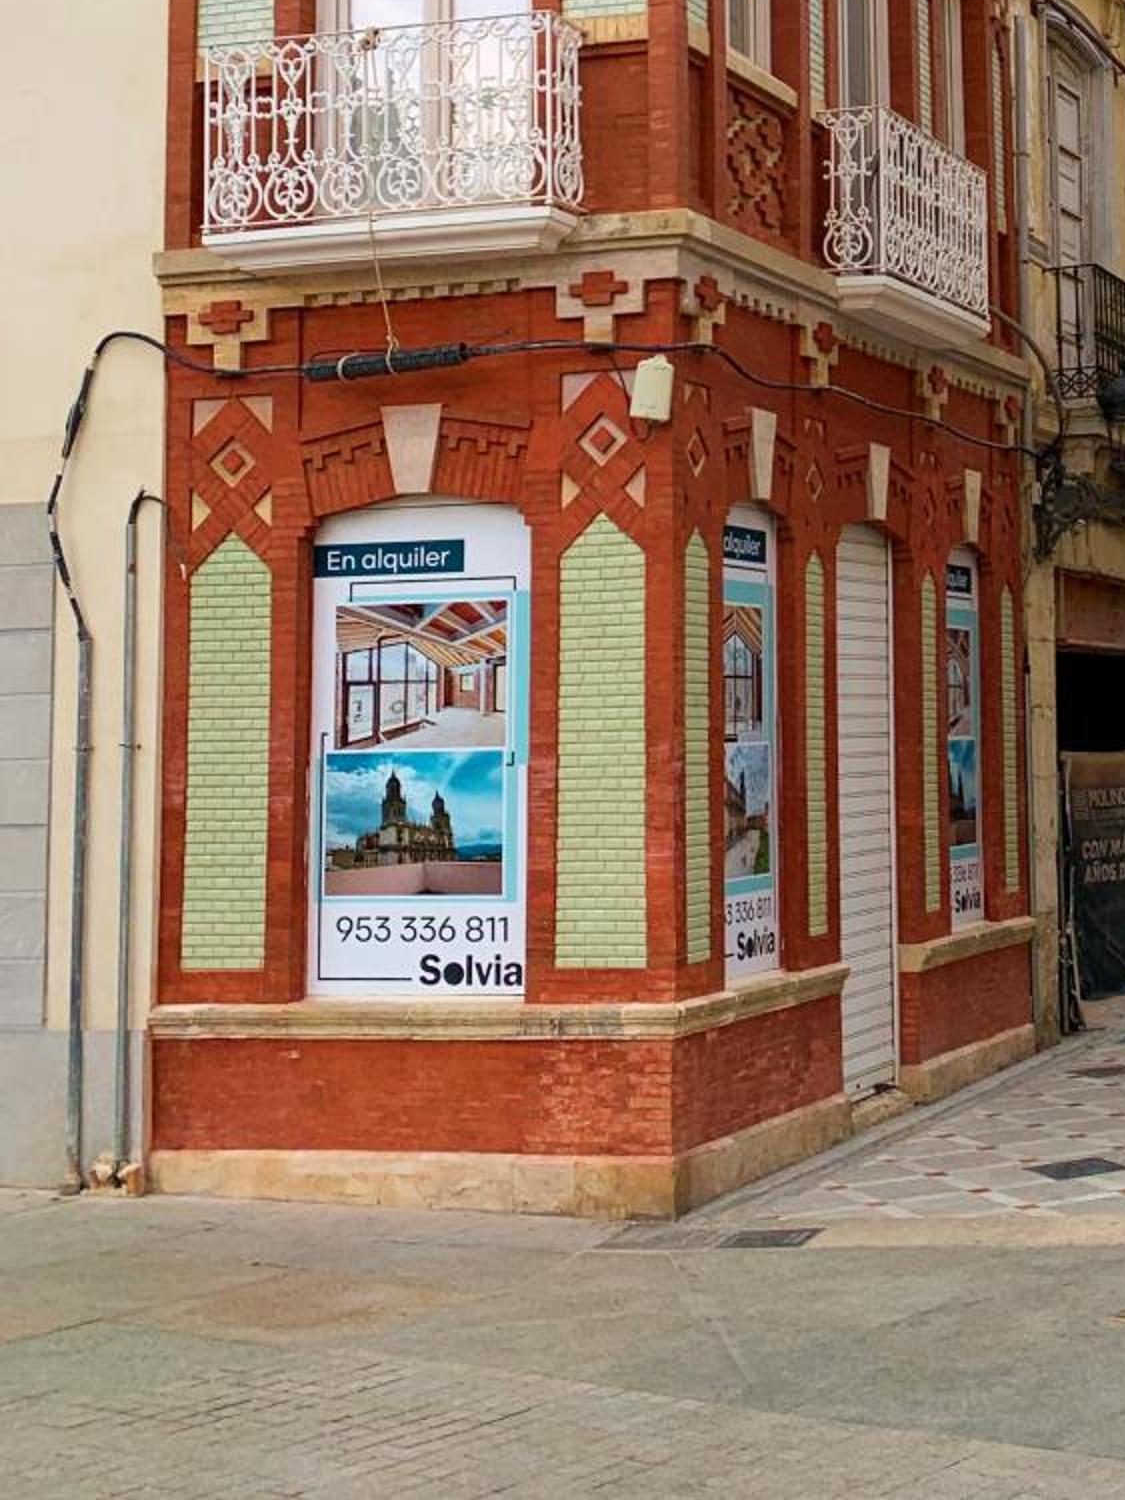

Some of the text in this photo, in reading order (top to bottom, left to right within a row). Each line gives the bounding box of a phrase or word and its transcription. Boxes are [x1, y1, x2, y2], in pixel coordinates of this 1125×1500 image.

[327, 546, 451, 573] En alquiler
[1081, 838, 1107, 860] CON
[1084, 860, 1117, 884] AÑOS
[336, 915, 509, 943] 953 336 811
[737, 926, 776, 961] Solvia
[419, 953, 523, 987] Solvia
